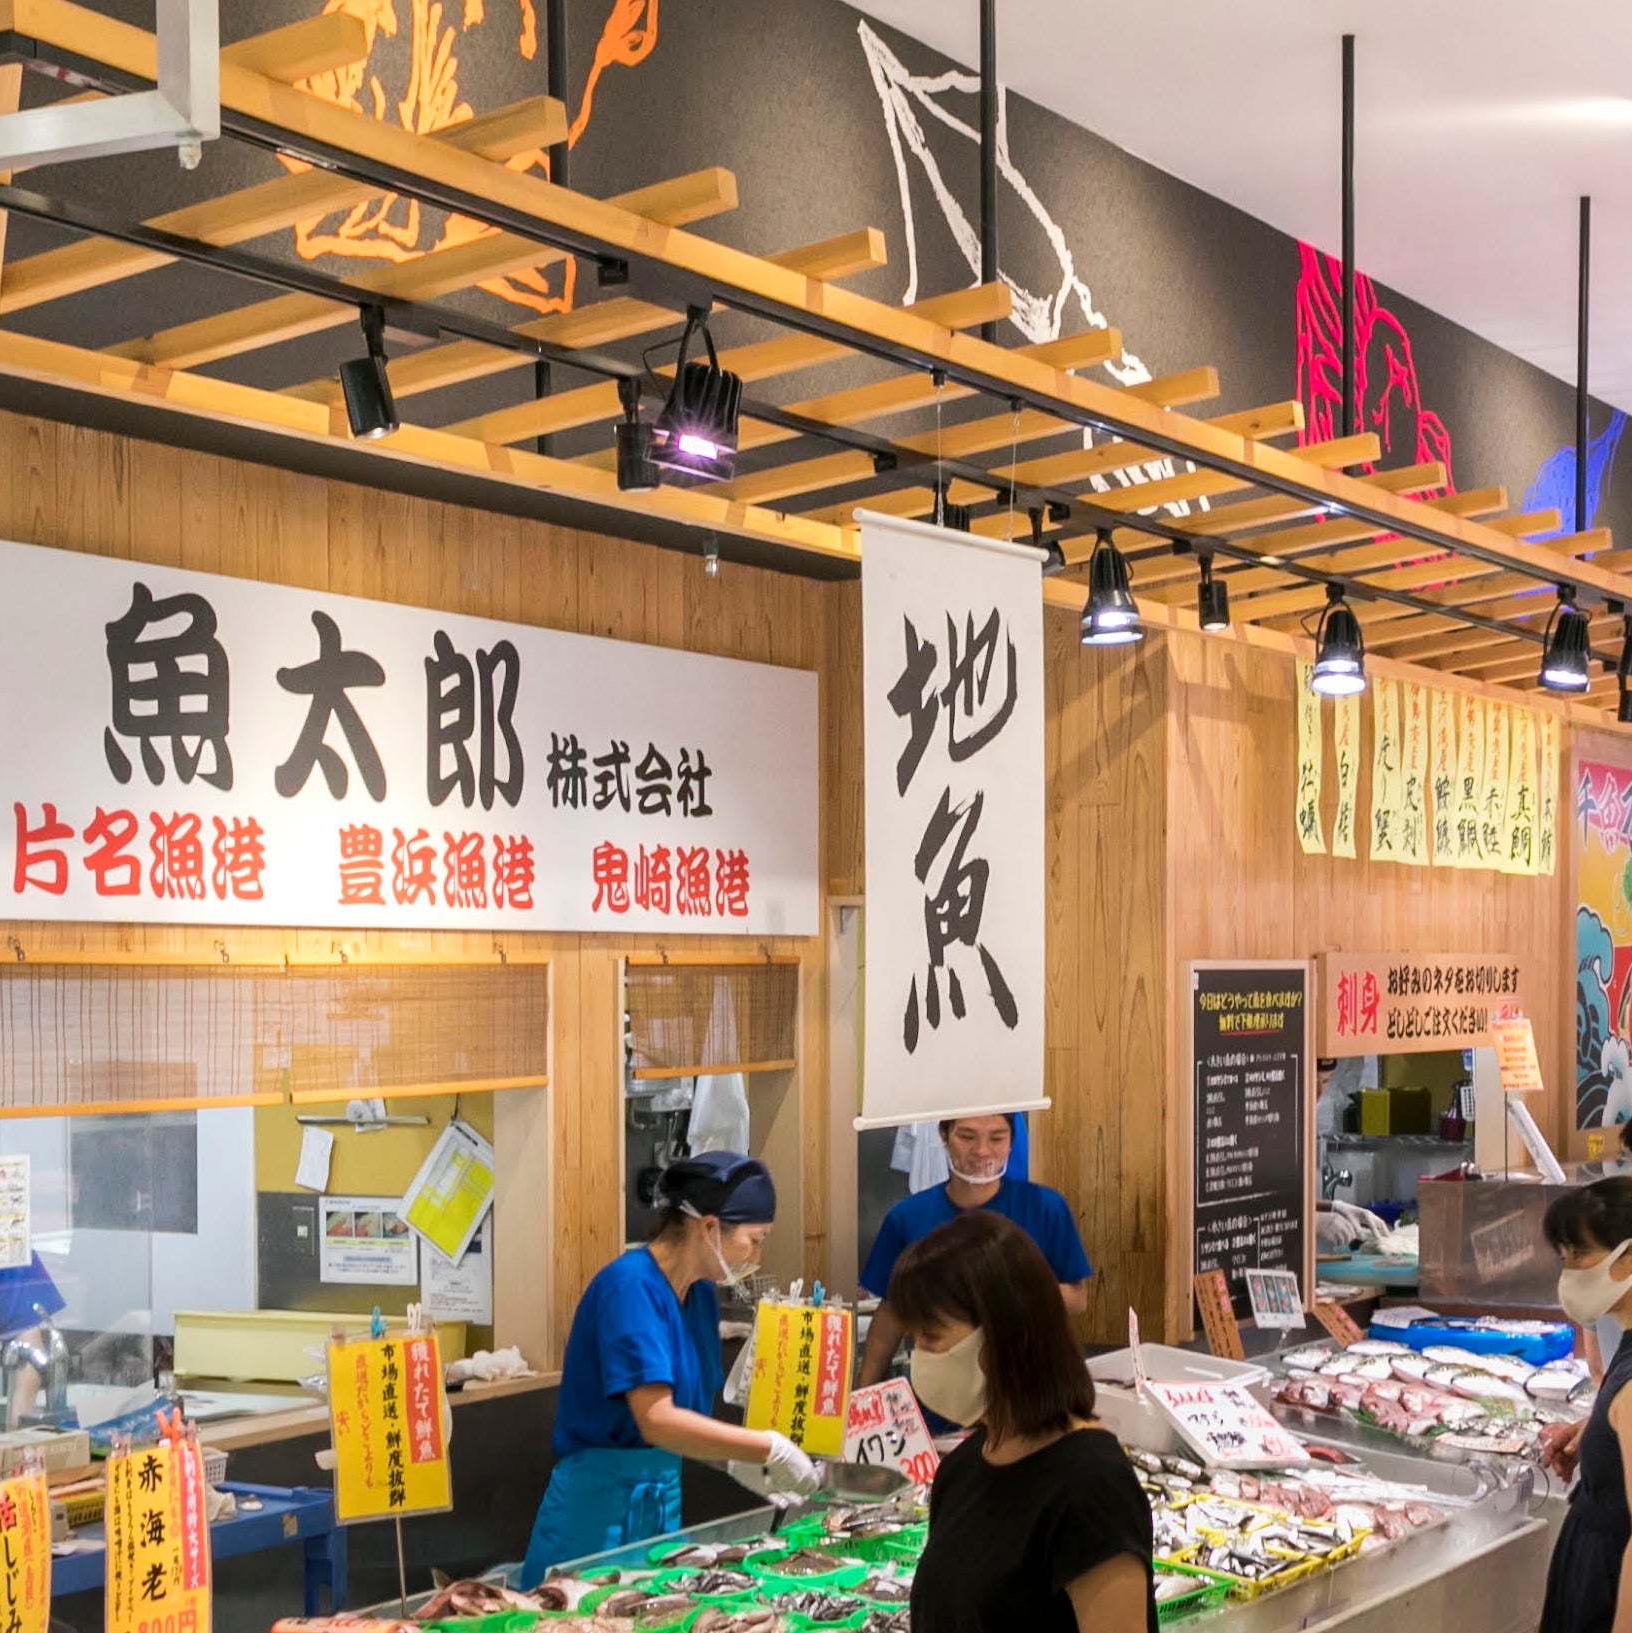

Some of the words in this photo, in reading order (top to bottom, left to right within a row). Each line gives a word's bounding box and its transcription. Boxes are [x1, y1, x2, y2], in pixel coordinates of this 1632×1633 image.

[103, 582, 526, 812] 魚太郎
[548, 732, 714, 819] 株式会社
[12, 802, 267, 904] 片名漁港
[338, 826, 536, 911] 豊浜漁港
[592, 844, 750, 919] 鬼崎漁港
[887, 609, 1020, 1054] 地魚
[1336, 969, 1381, 1037] 刺身
[1386, 964, 1520, 997] お好みのネタをお切りします
[410, 1339, 436, 1462] 獲れたて鮮魚
[137, 1454, 168, 1603] 赤海老
